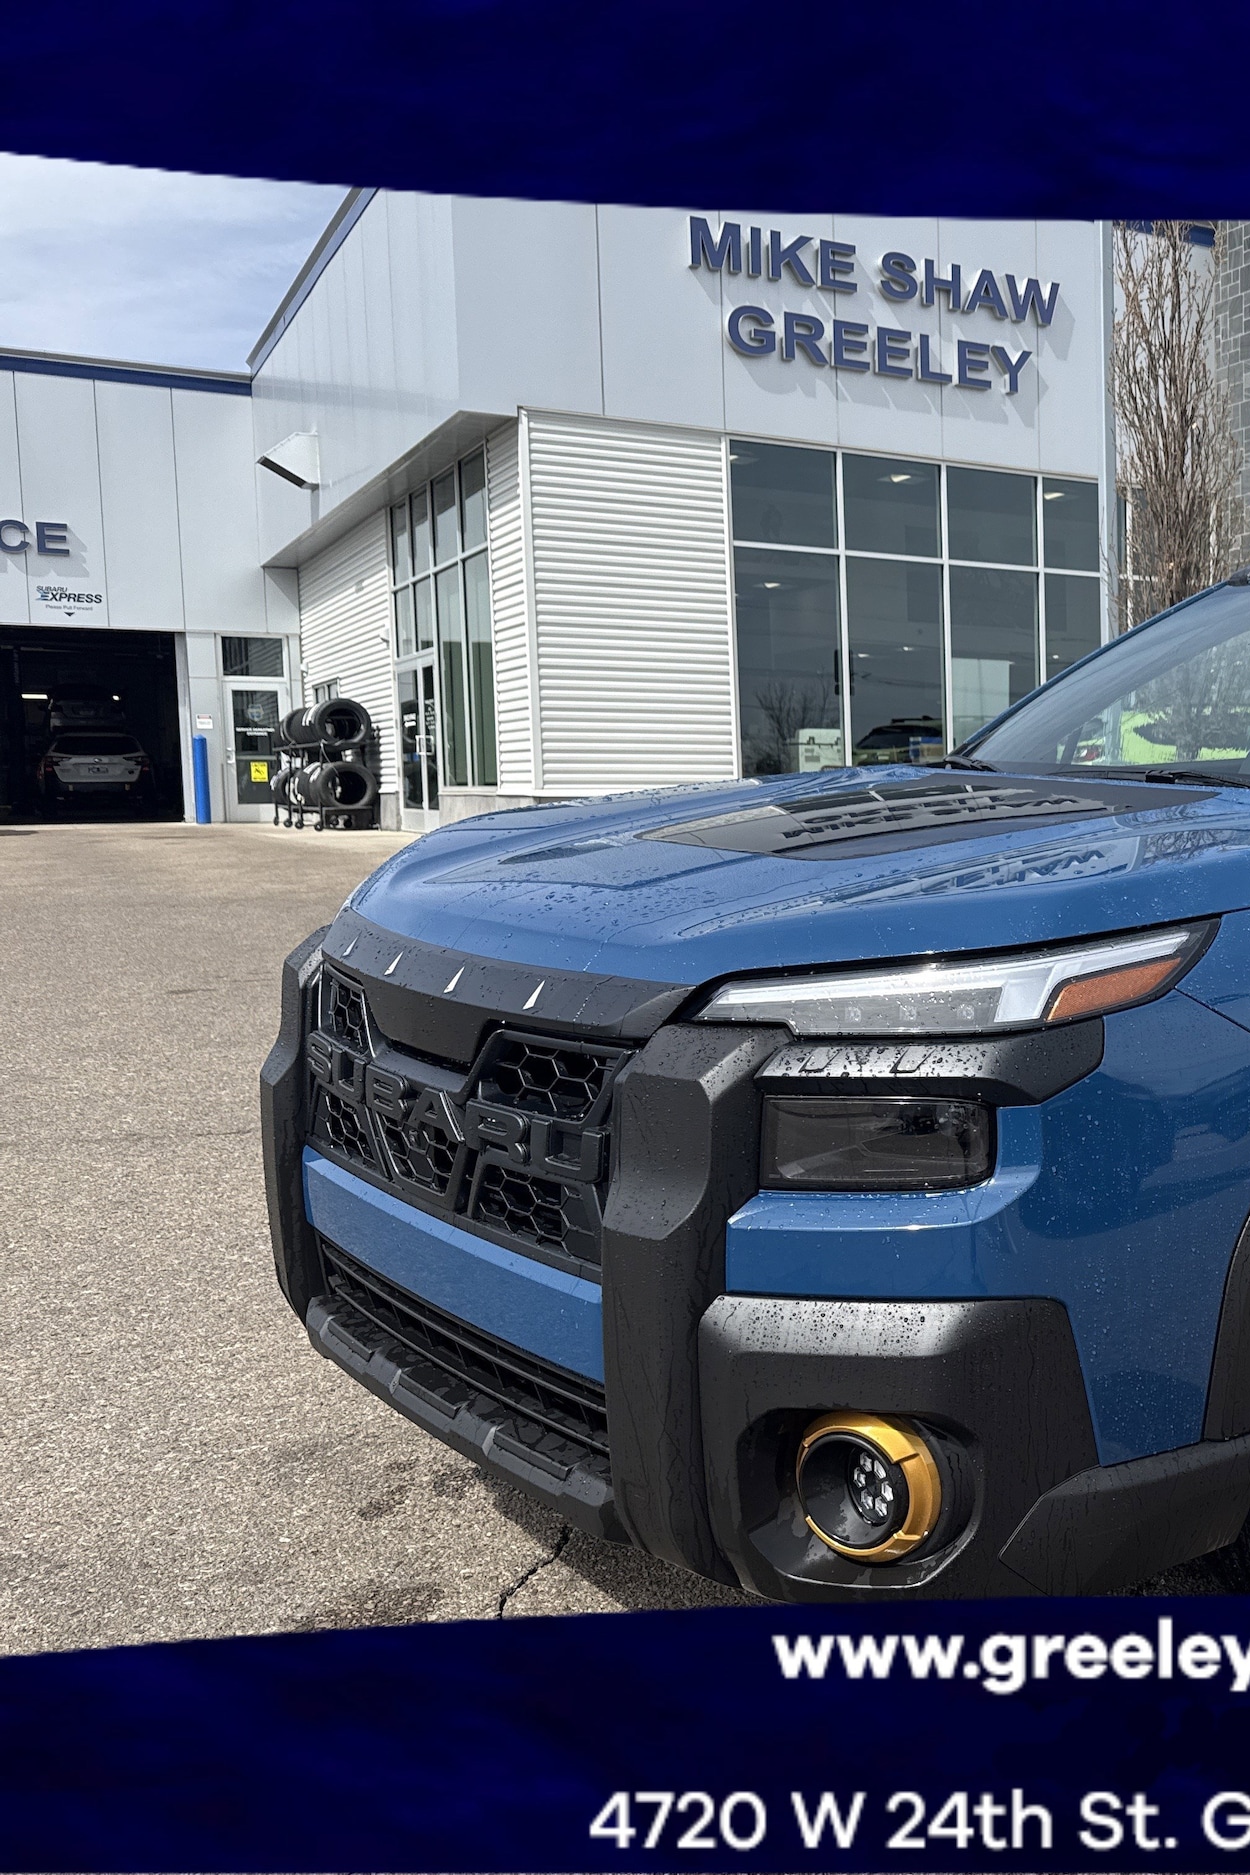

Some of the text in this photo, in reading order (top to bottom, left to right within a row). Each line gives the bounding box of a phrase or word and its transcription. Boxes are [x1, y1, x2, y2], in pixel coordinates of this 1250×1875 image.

[688, 216, 1060, 326] MIKE SHAW
[726, 305, 1032, 394] GREELEY
[0, 519, 70, 557] CE
[36, 585, 68, 593] SUBARU
[36, 591, 103, 604] EXPRESS
[307, 1031, 611, 1185] SUBARU
